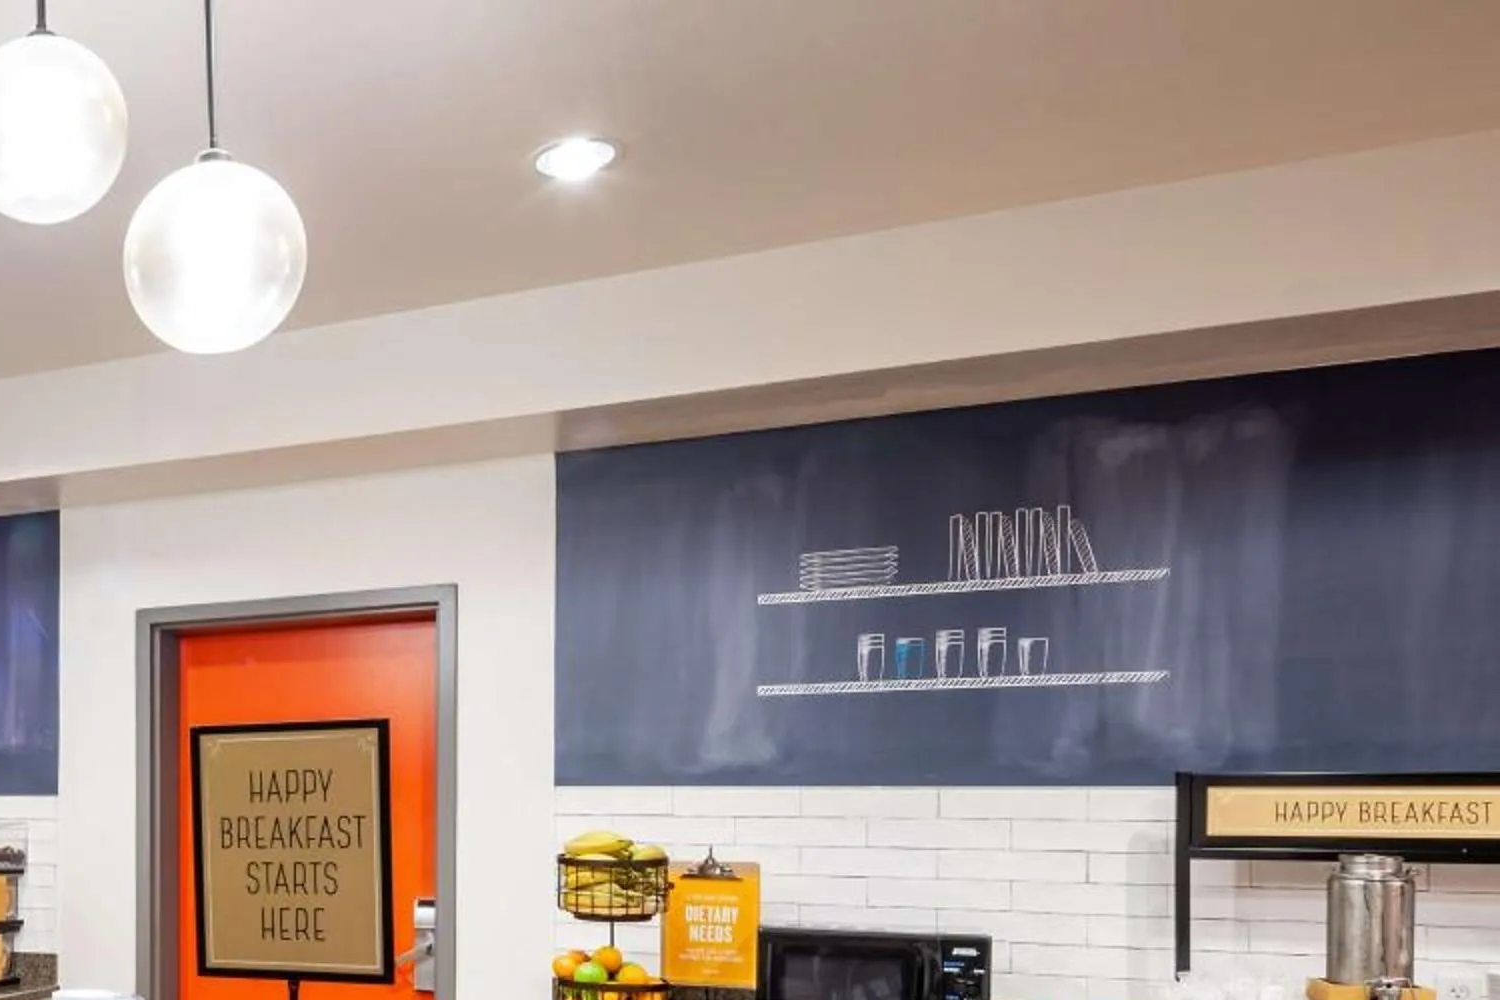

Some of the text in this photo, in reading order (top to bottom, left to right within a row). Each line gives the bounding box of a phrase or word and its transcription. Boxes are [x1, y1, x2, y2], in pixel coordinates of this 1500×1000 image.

[248, 768, 333, 804] HAPPY
[1274, 800, 1493, 825] HAPPY BREAKFAST
[220, 815, 367, 850] BREAKFAST
[245, 861, 339, 896] STARTS
[260, 907, 327, 942] HERE
[685, 903, 739, 925] DIETARY
[688, 923, 734, 943] NEEDS
